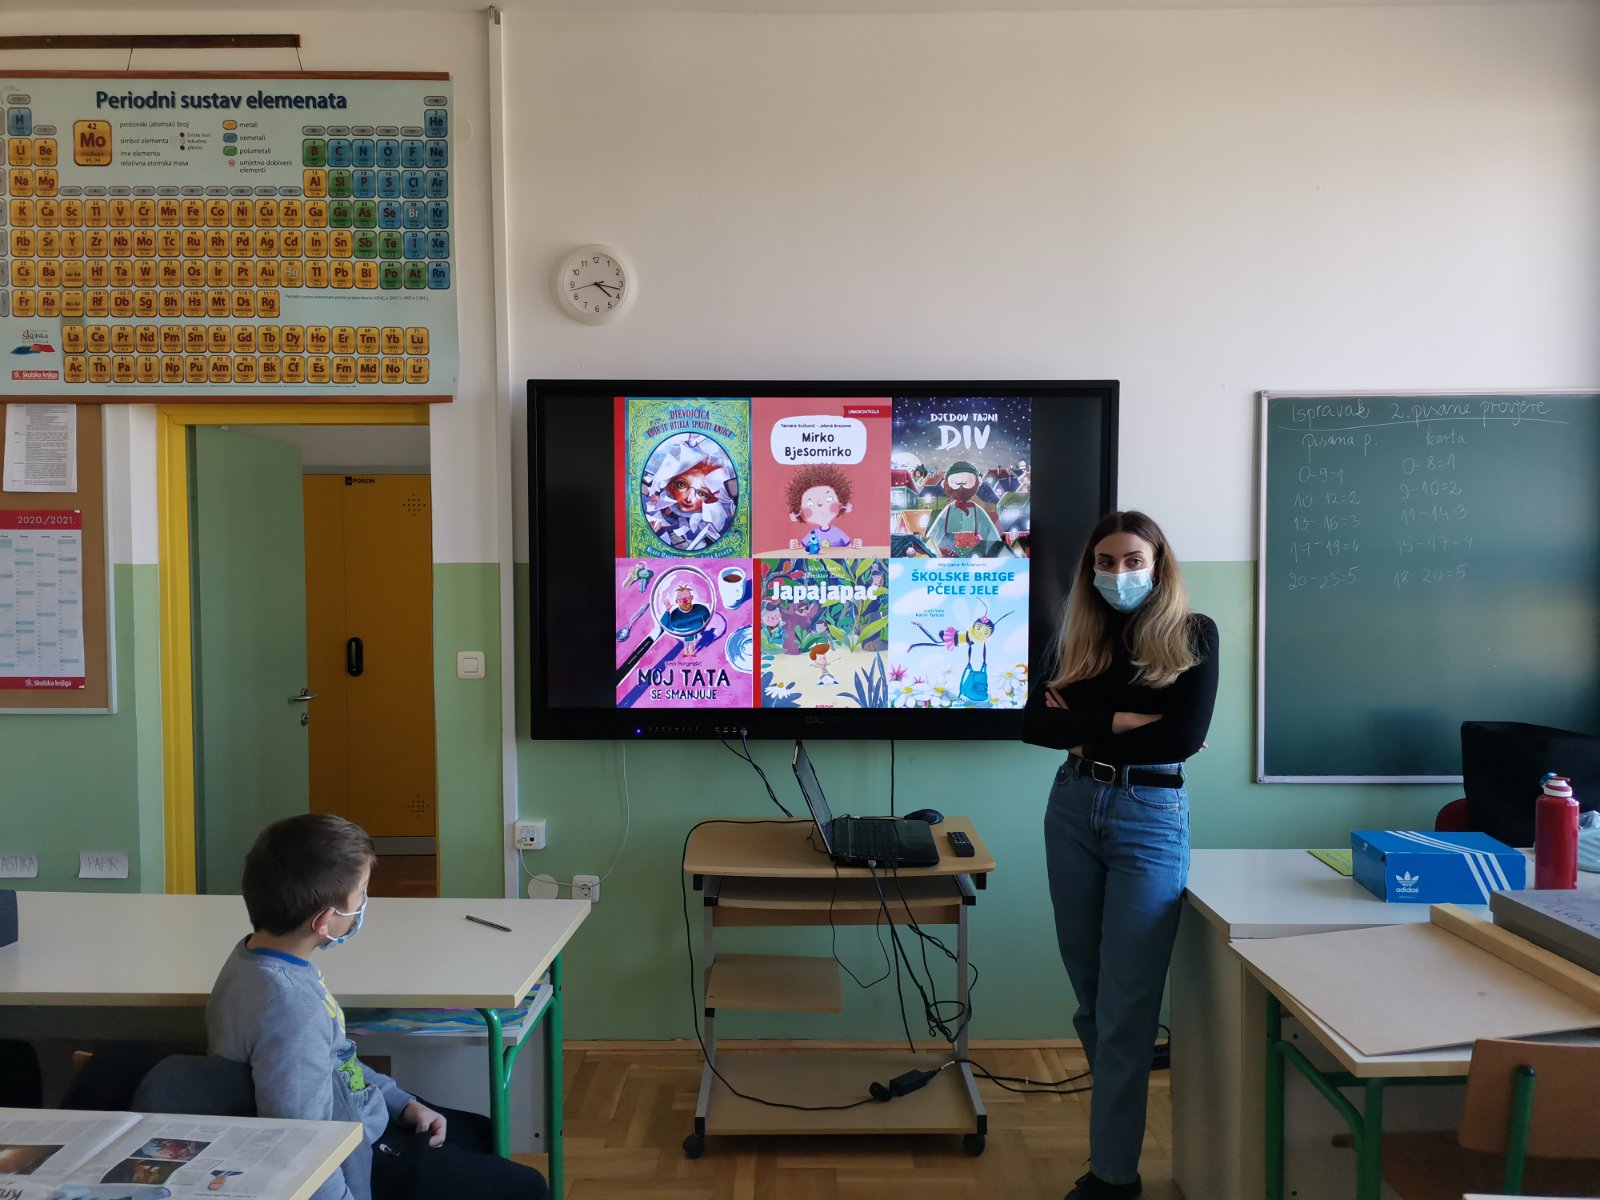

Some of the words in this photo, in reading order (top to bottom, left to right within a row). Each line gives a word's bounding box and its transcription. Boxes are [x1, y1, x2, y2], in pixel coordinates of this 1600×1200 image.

[96, 90, 176, 109] Periodni
[181, 94, 242, 109] sustav
[246, 90, 347, 109] elemenata
[15, 115, 24, 125] H
[429, 116, 443, 126] He
[80, 132, 106, 148] Mo
[39, 146, 52, 156] Be
[334, 146, 344, 156] C
[359, 146, 368, 156] N
[383, 146, 393, 156] O
[430, 147, 444, 157] Ne
[14, 176, 29, 186] Na
[38, 177, 55, 188] Mg
[360, 177, 368, 187] P
[385, 177, 393, 187] S
[432, 178, 444, 188] Ar
[19, 206, 26, 216] K
[41, 207, 54, 217] Ca
[66, 207, 78, 217] Sc
[116, 207, 124, 217] V
[138, 207, 150, 217] Cr
[161, 207, 177, 217] Mn
[187, 207, 200, 217] Fe
[210, 207, 225, 217] Co
[260, 207, 274, 217] Cu
[284, 207, 298, 217] Zn
[309, 207, 323, 217] Ga
[358, 207, 372, 217] As
[383, 208, 396, 218] Se
[432, 208, 443, 218] Kr
[16, 237, 30, 247] Rb
[43, 237, 54, 247] Sr
[69, 237, 76, 247] Y
[91, 237, 102, 247] Zr
[113, 237, 128, 247] Nb
[137, 237, 153, 247] Mo
[187, 237, 201, 247] Ru
[212, 237, 225, 247] Rh
[236, 237, 250, 247] Pd
[260, 238, 274, 249] Ag
[284, 237, 298, 247] Cd
[311, 237, 321, 247] In
[334, 237, 347, 247] Sn
[432, 238, 445, 248] Xe
[92, 267, 103, 277] Hf
[116, 267, 128, 277] Ta
[238, 267, 249, 277] Pt
[260, 267, 275, 277] Au
[334, 267, 349, 277] Pb
[432, 268, 446, 278] Rn
[114, 297, 130, 307] Db
[188, 297, 202, 307] Hs
[261, 298, 275, 309] Rg
[67, 333, 80, 343] La
[311, 334, 326, 344] Ho
[144, 362, 152, 372] U
[360, 364, 376, 374] Md
[670, 408, 710, 420] DJEVOJČICA
[1390, 403, 1410, 419] 2.
[930, 413, 968, 422] DJEDOV
[973, 413, 998, 422] TAJNI
[802, 432, 835, 442] Mirko
[934, 424, 990, 451] DIV
[785, 446, 852, 460] Bjesomirko
[17, 516, 76, 525] 2020./2021.
[911, 569, 970, 582] ŠKOLSKE
[974, 572, 1015, 582] BRIGE
[927, 582, 966, 595] PČELE
[970, 586, 999, 595] JELE
[638, 669, 674, 686] MOJ
[682, 669, 730, 686] TATA
[651, 689, 662, 699] SE
[666, 689, 717, 700] SMANJUJE
